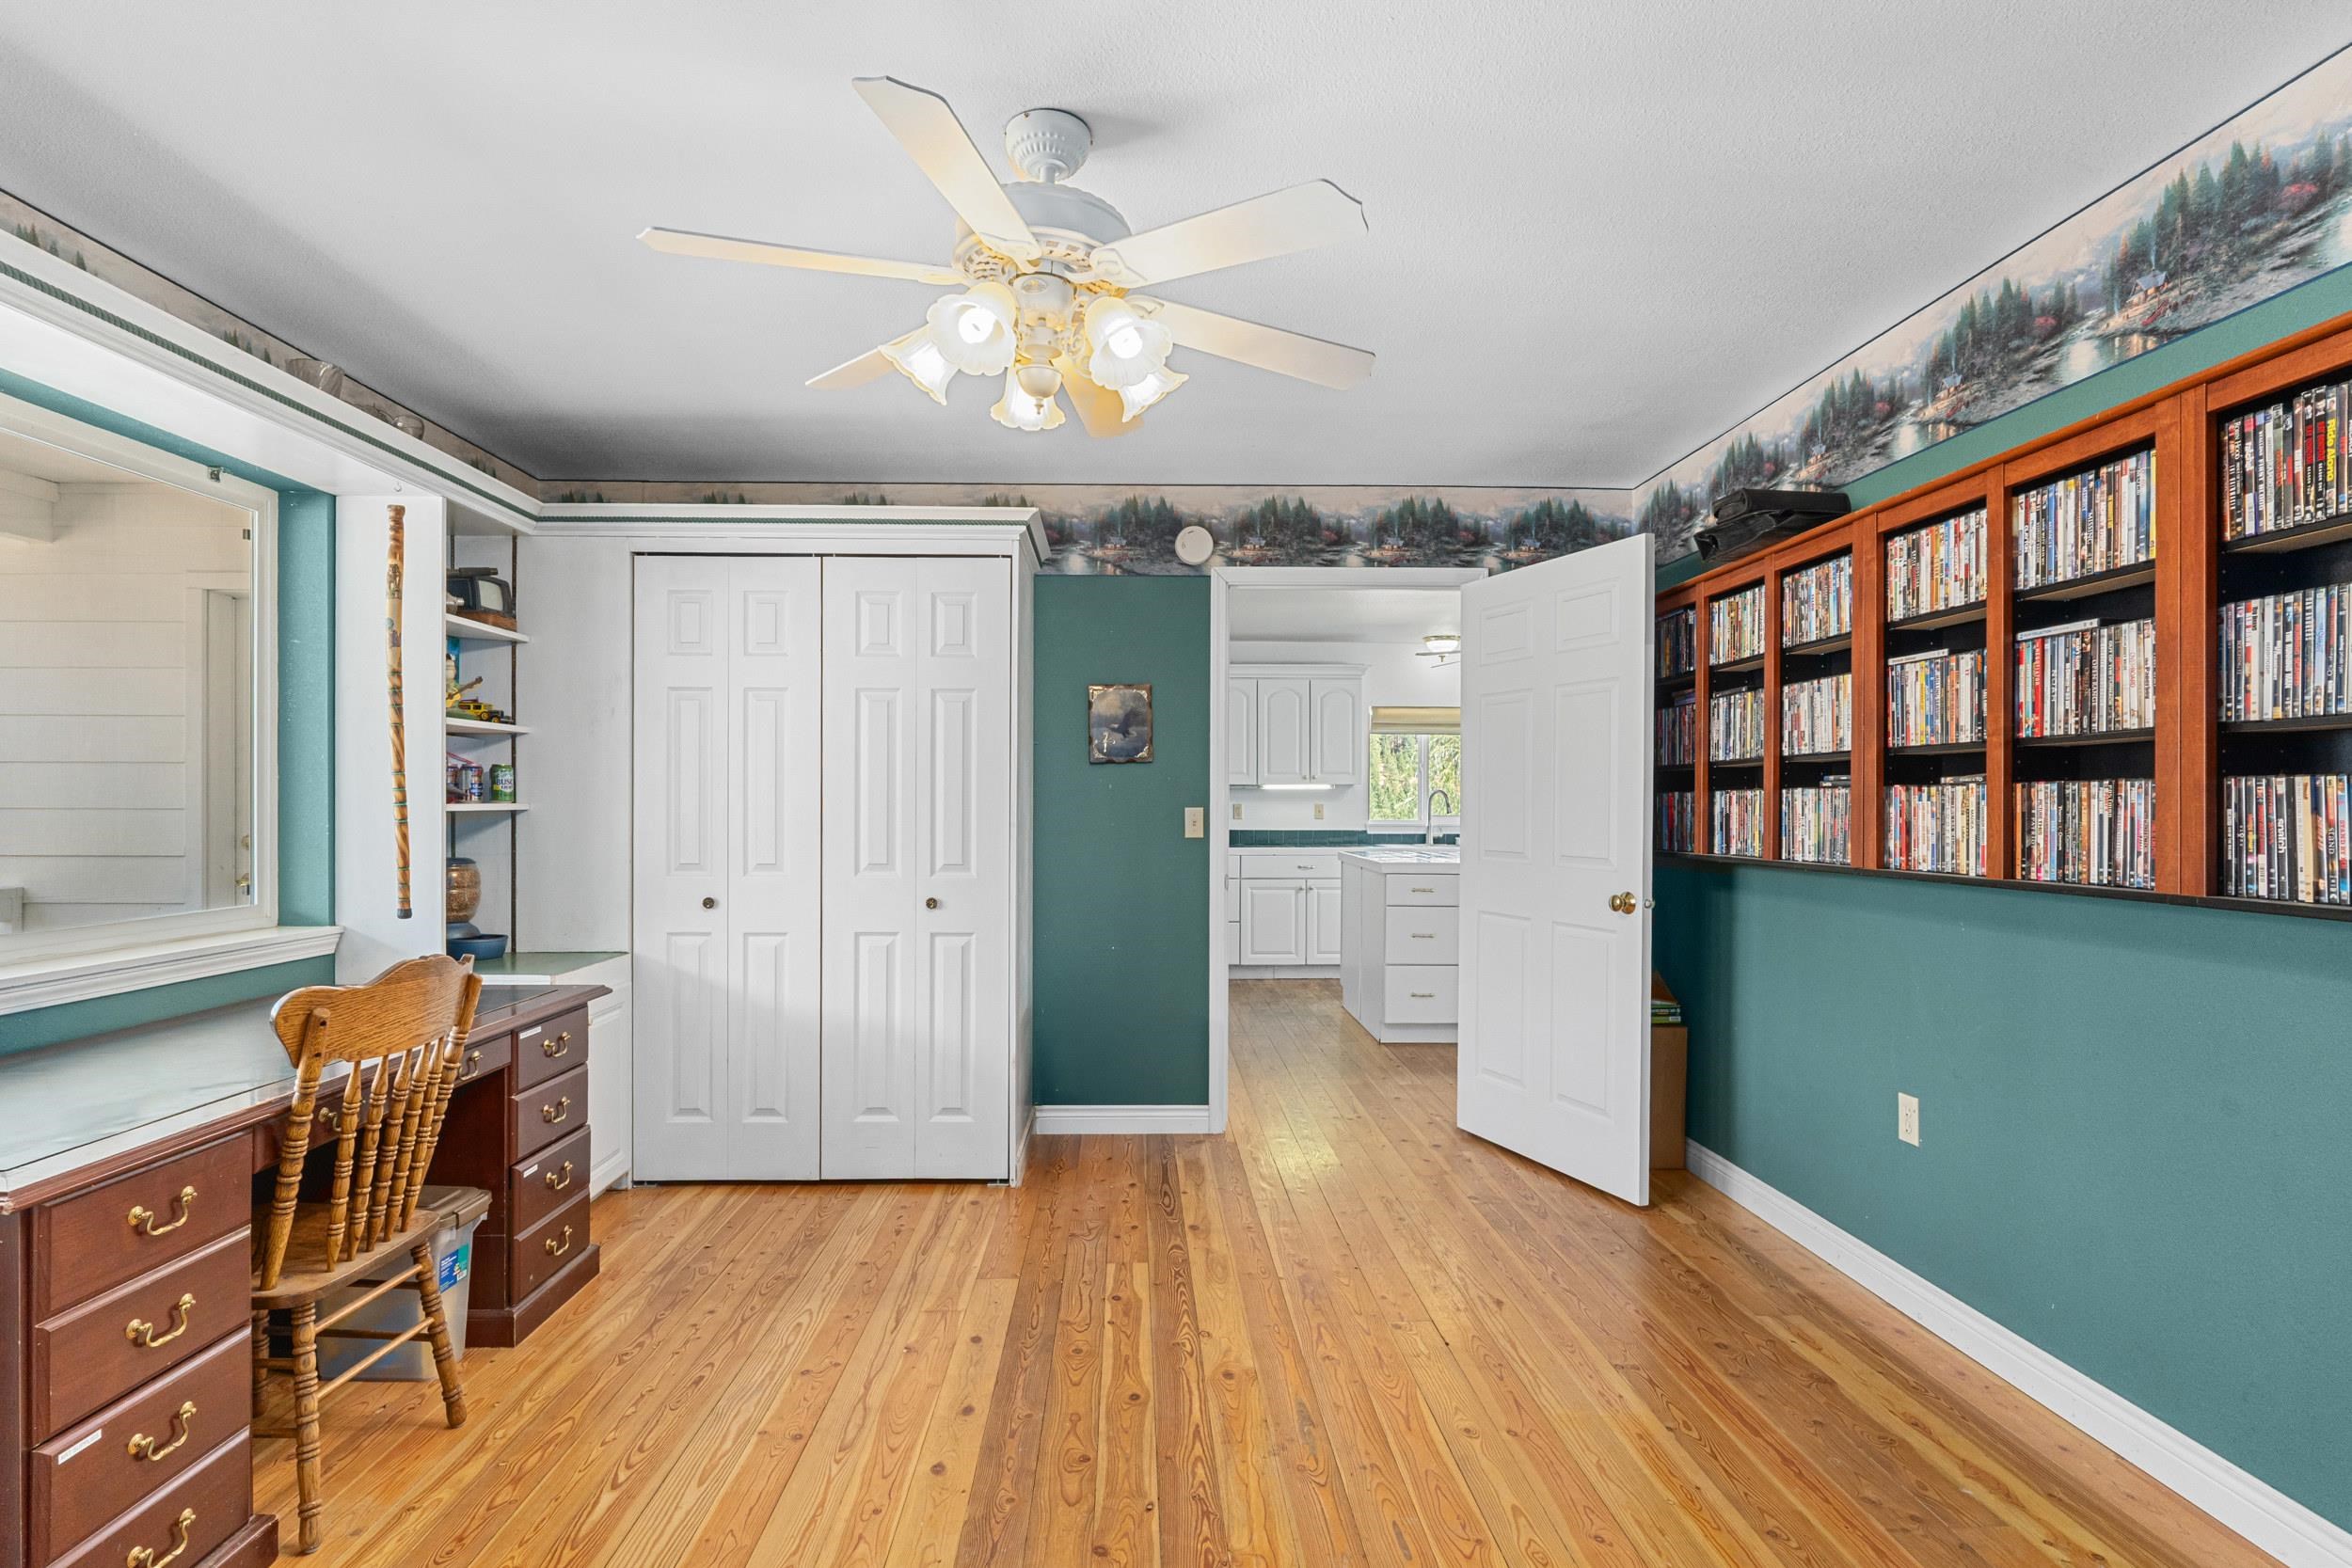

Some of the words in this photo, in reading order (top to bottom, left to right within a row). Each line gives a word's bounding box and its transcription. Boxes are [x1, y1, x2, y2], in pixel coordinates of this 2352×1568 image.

[2327, 419, 2337, 447] Ride
[2327, 448, 2337, 482] Along
[2278, 818, 2286, 854] snatch
